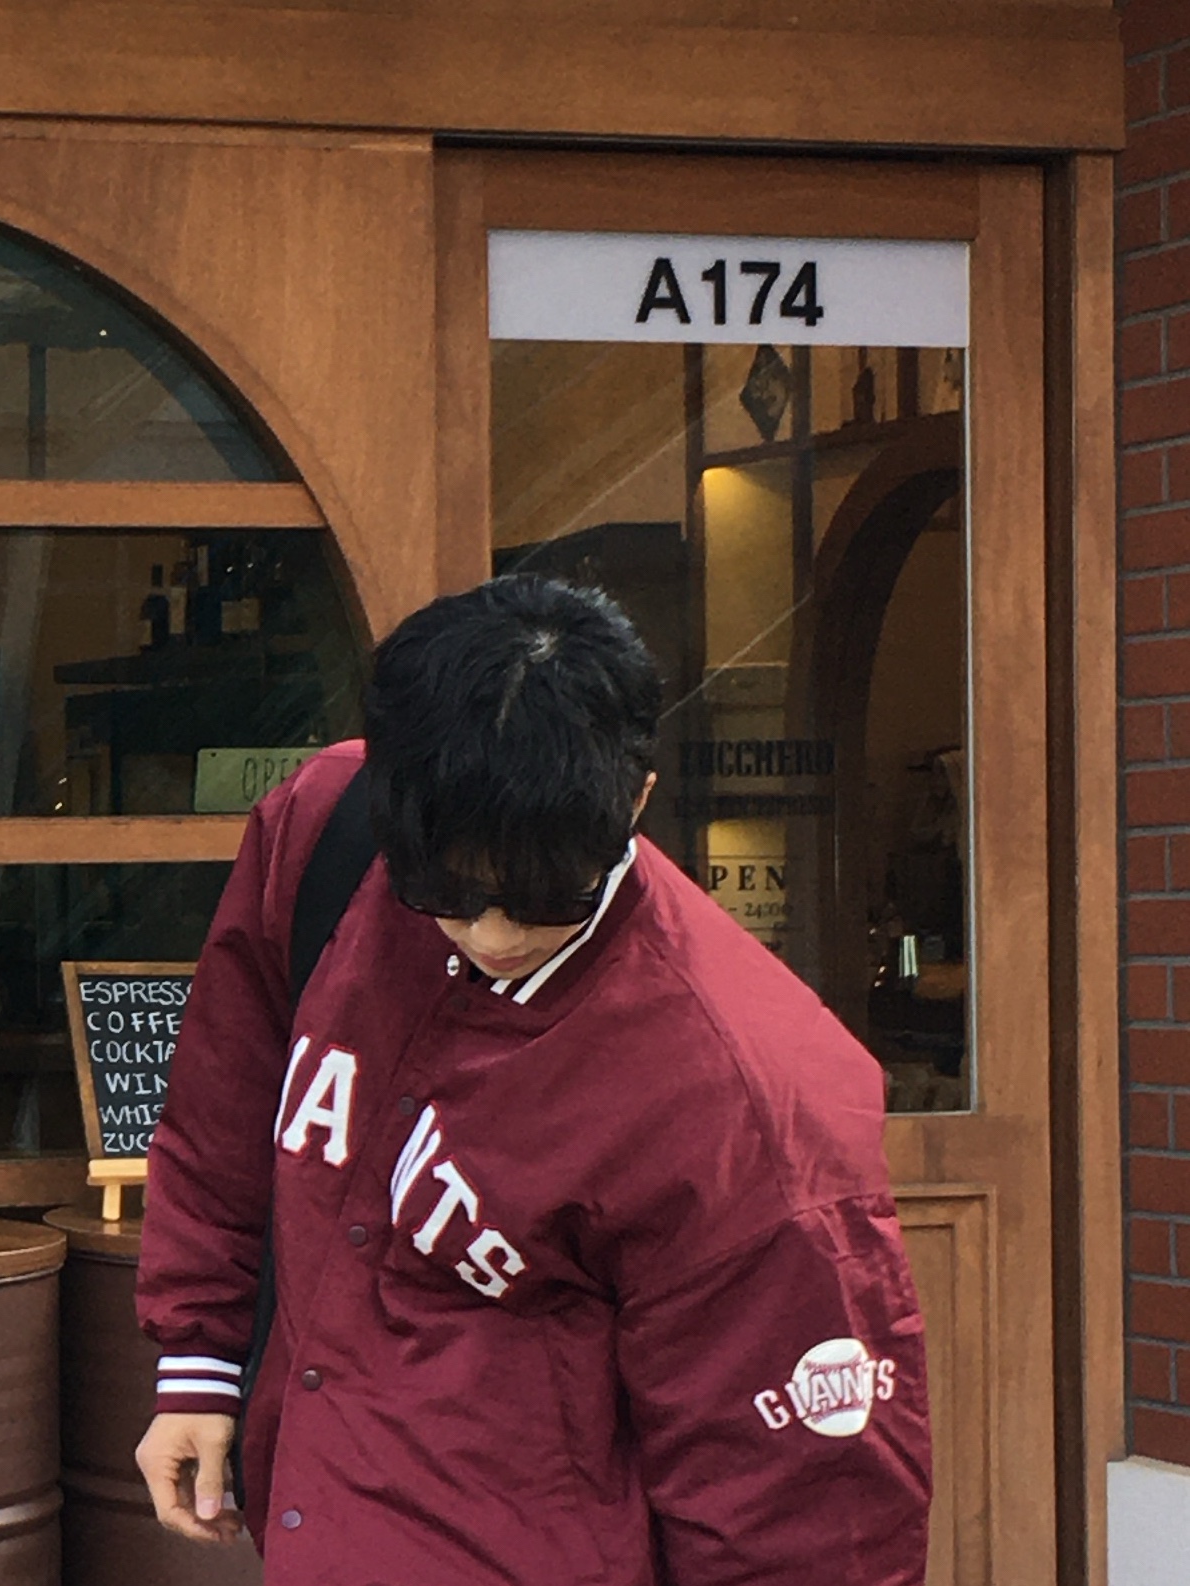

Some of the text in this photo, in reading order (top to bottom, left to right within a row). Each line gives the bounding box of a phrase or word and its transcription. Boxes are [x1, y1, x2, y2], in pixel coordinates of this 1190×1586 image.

[636, 257, 824, 327] A174
[242, 757, 302, 802] OP
[684, 864, 787, 892] PEN
[87, 1011, 183, 1035] COFFE
[90, 1040, 177, 1064] COCKTA
[105, 1072, 170, 1095] WIN
[100, 1104, 165, 1126] WHIS
[753, 1358, 896, 1430] GIANTS
